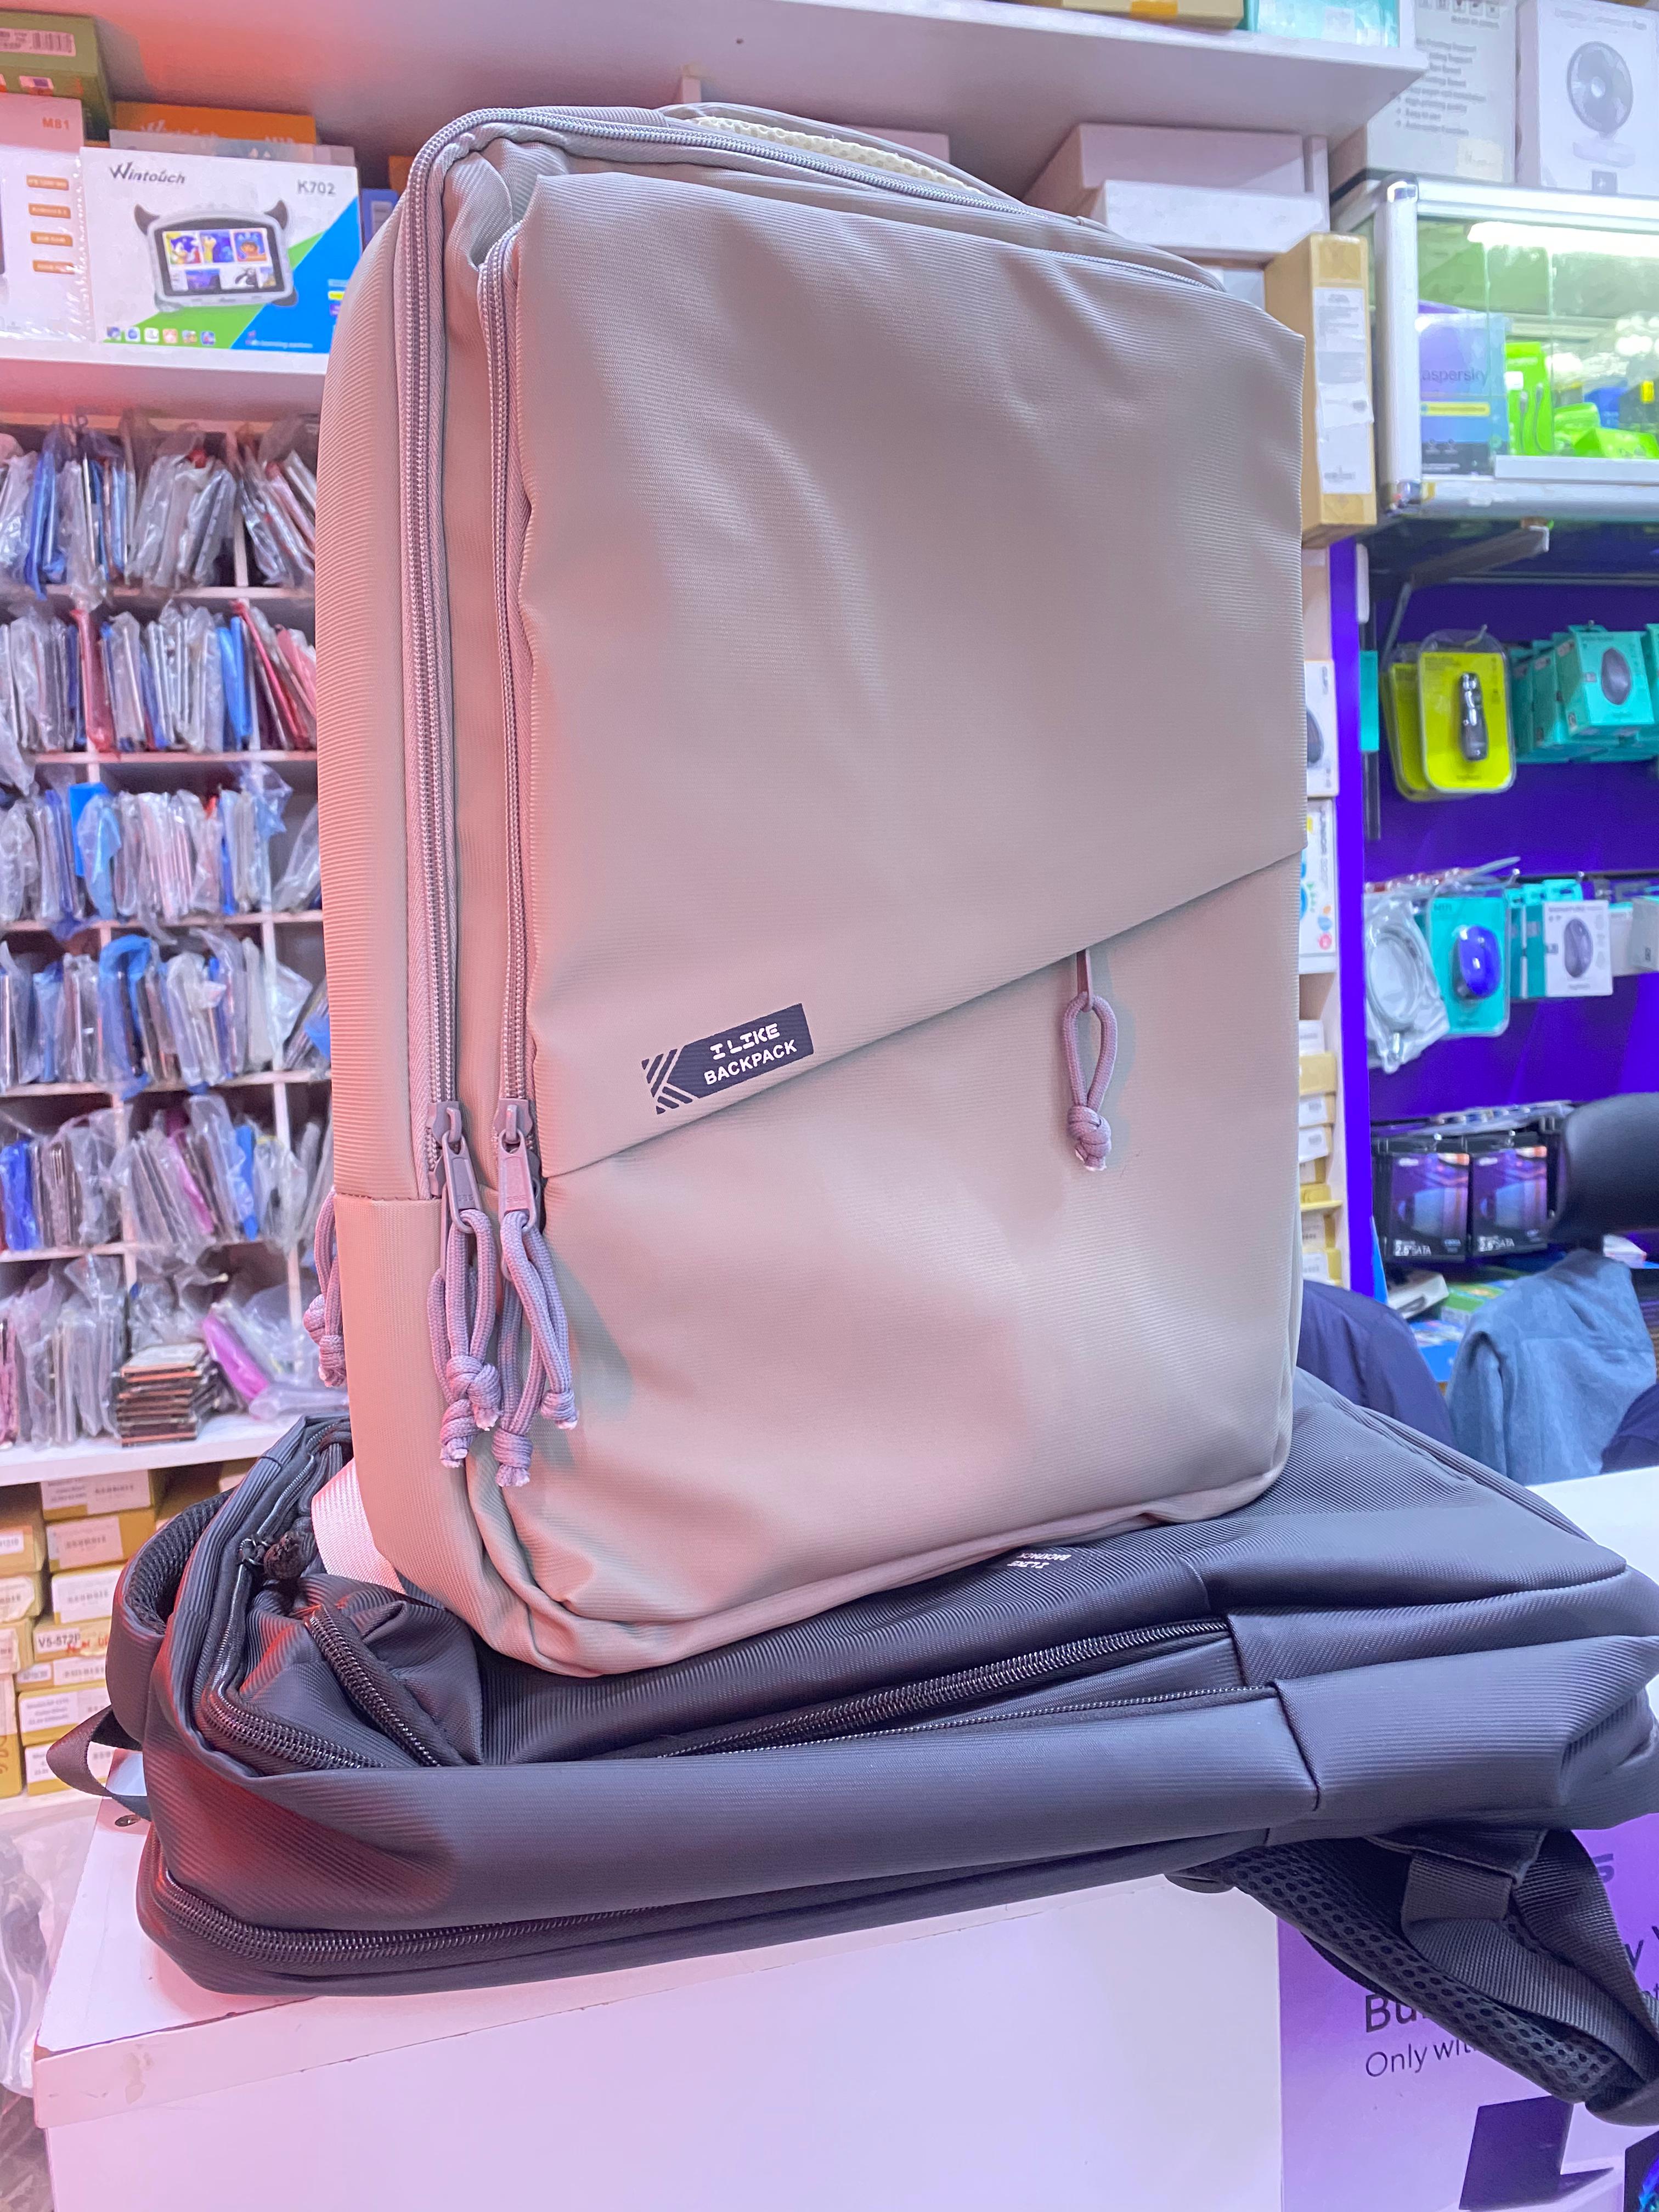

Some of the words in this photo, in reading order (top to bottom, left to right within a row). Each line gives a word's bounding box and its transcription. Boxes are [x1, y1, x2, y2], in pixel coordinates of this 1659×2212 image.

[109, 162, 185, 184] Wintouch
[297, 179, 336, 195] K702
[1421, 368, 1486, 386] aspersky
[710, 1043, 726, 1060] I
[726, 1023, 780, 1054] LIKE
[703, 1039, 797, 1085] BACKPACK
[1365, 2043, 1427, 2077] Only
